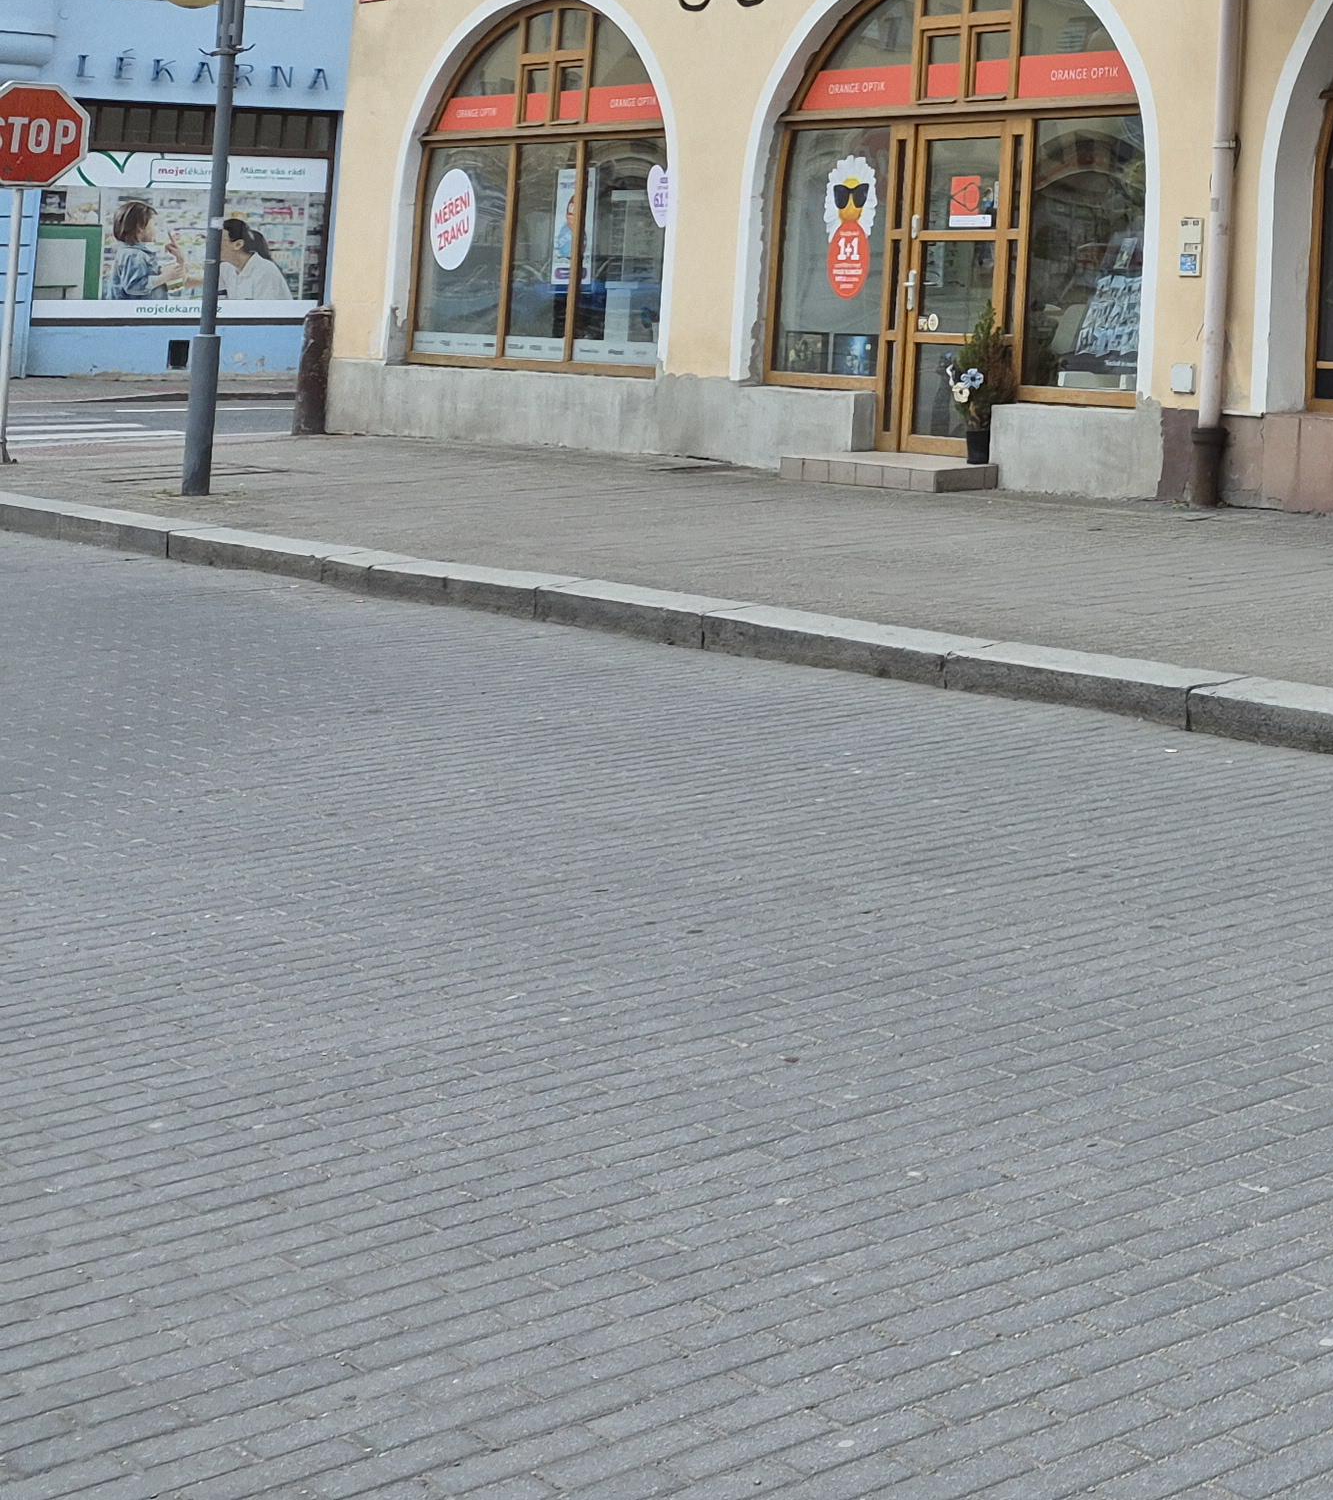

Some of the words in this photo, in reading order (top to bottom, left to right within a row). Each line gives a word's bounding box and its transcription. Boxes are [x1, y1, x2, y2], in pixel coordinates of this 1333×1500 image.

[1050, 69, 1088, 81] ORANGE
[1091, 66, 1119, 79] OPTIK
[828, 82, 860, 94] ORANGE
[862, 81, 885, 93] OPTIK
[0, 116, 76, 155] TOP
[434, 188, 470, 229] MĚŘENÍ
[437, 215, 470, 251] ZRAKU
[837, 236, 860, 260] 1+1
[136, 303, 223, 315] mojelekarnz
